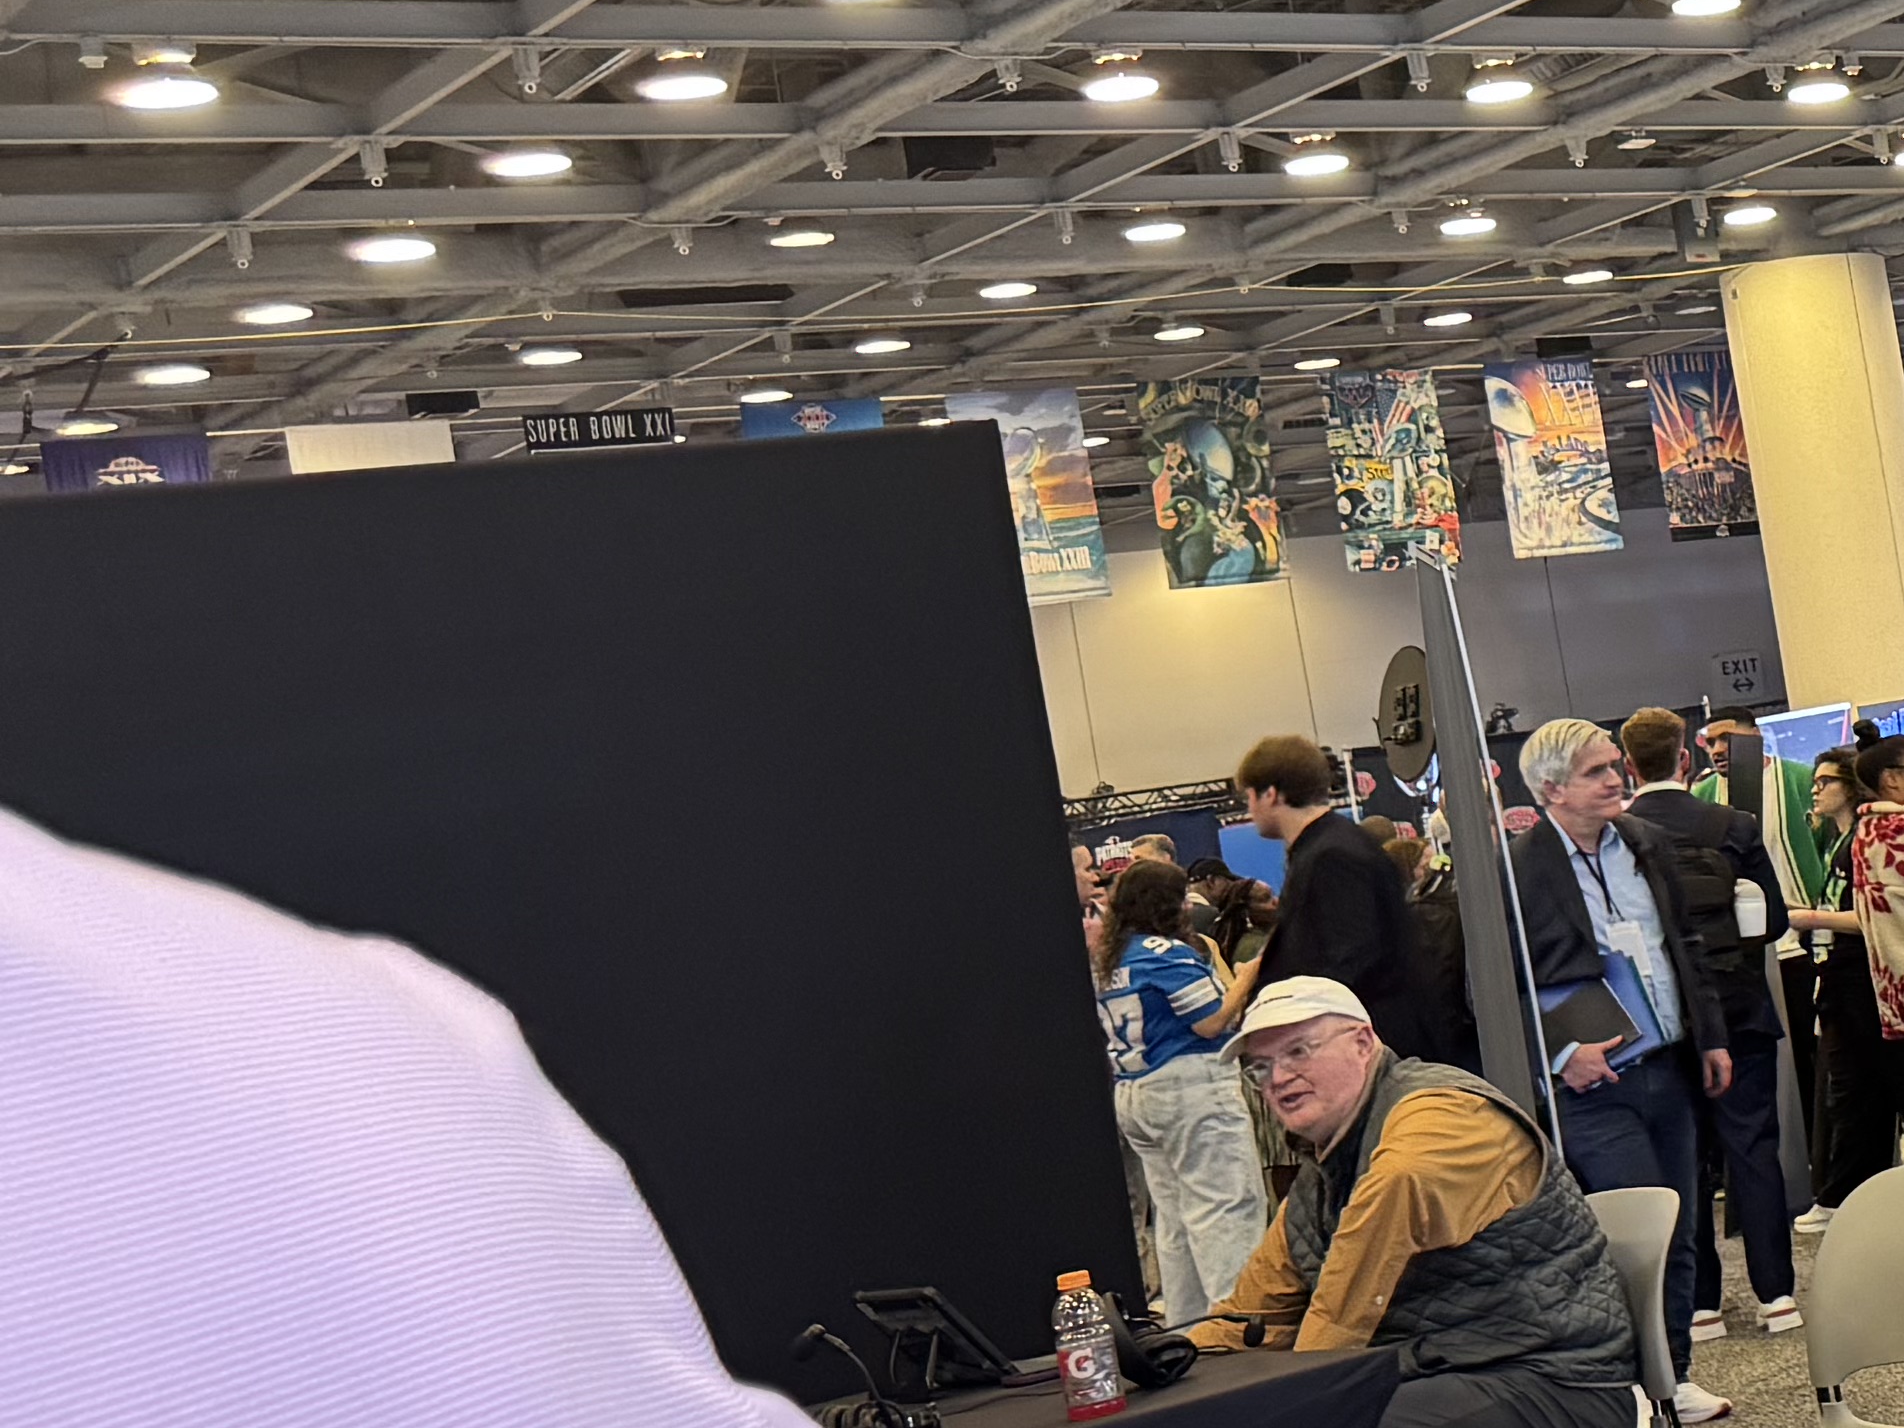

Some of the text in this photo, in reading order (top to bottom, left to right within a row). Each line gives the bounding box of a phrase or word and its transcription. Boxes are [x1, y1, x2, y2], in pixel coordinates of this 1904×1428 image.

[527, 418, 579, 443] SUPER
[590, 415, 637, 439] BOWL
[1721, 655, 1758, 676] EXIT
[1067, 1348, 1098, 1379] G
